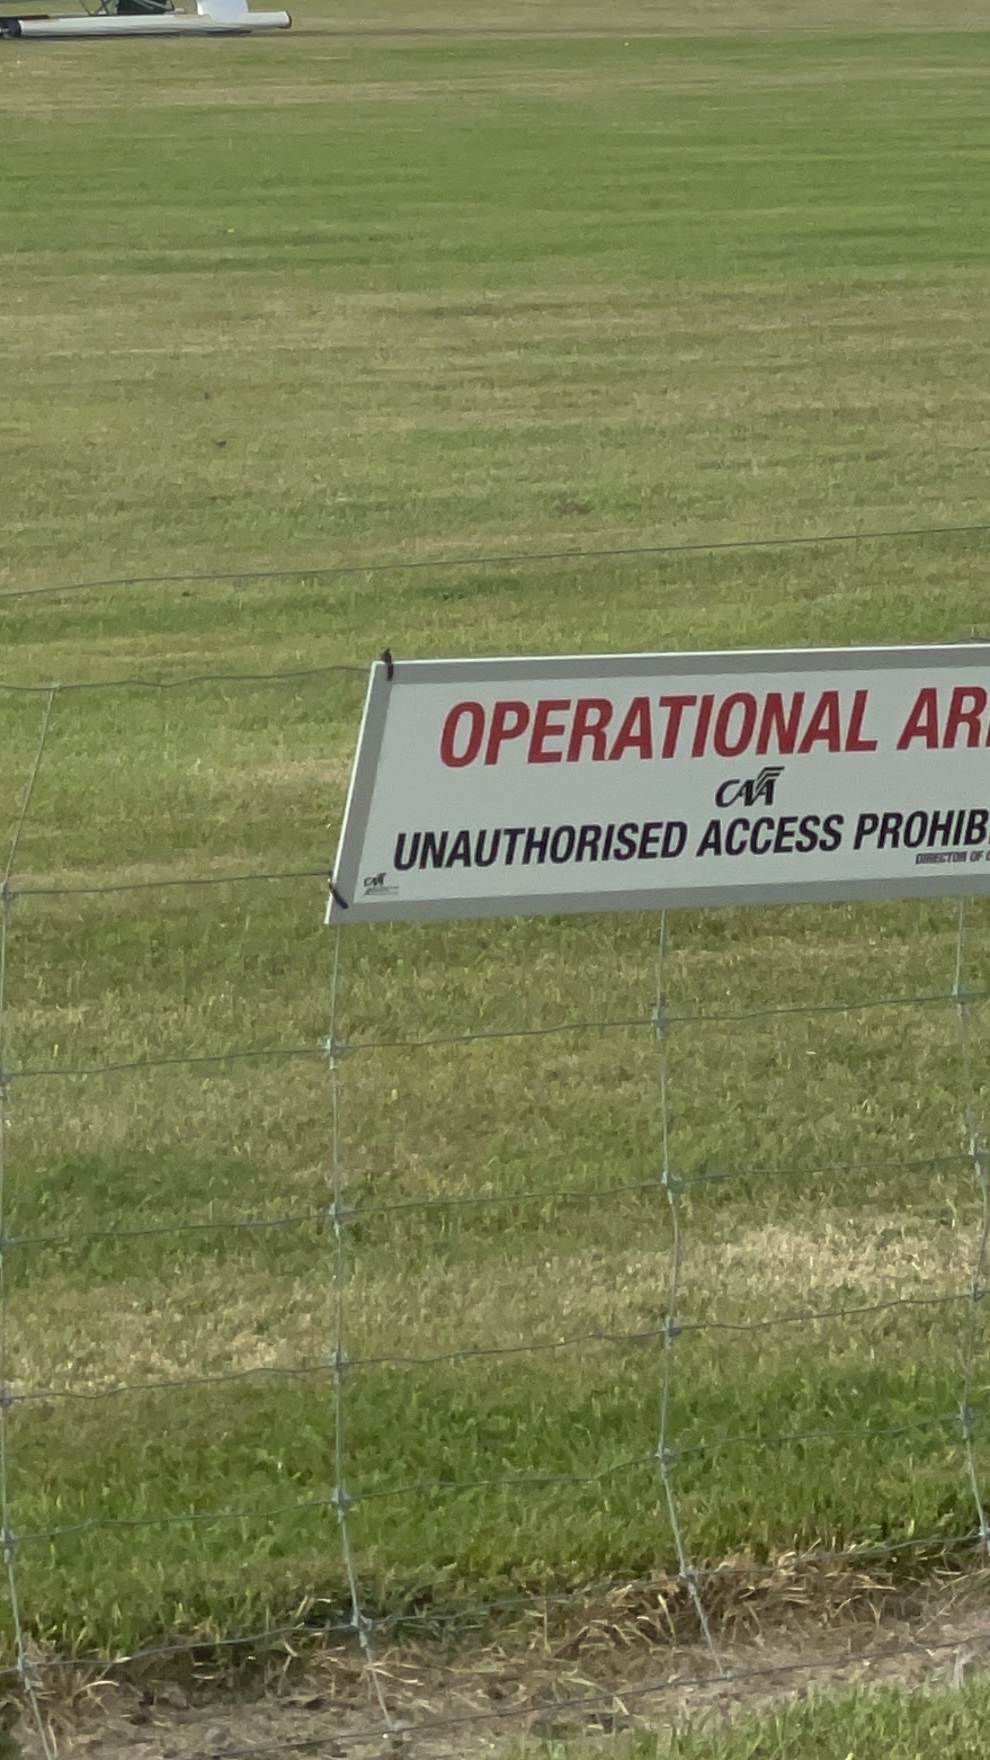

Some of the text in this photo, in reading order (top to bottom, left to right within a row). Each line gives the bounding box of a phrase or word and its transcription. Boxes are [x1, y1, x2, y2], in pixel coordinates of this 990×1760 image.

[440, 686, 990, 768] OPERATIONAL AR
[715, 766, 785, 808] CAA
[393, 808, 990, 871] UNAUTHORISED ACCESS PROHIB
